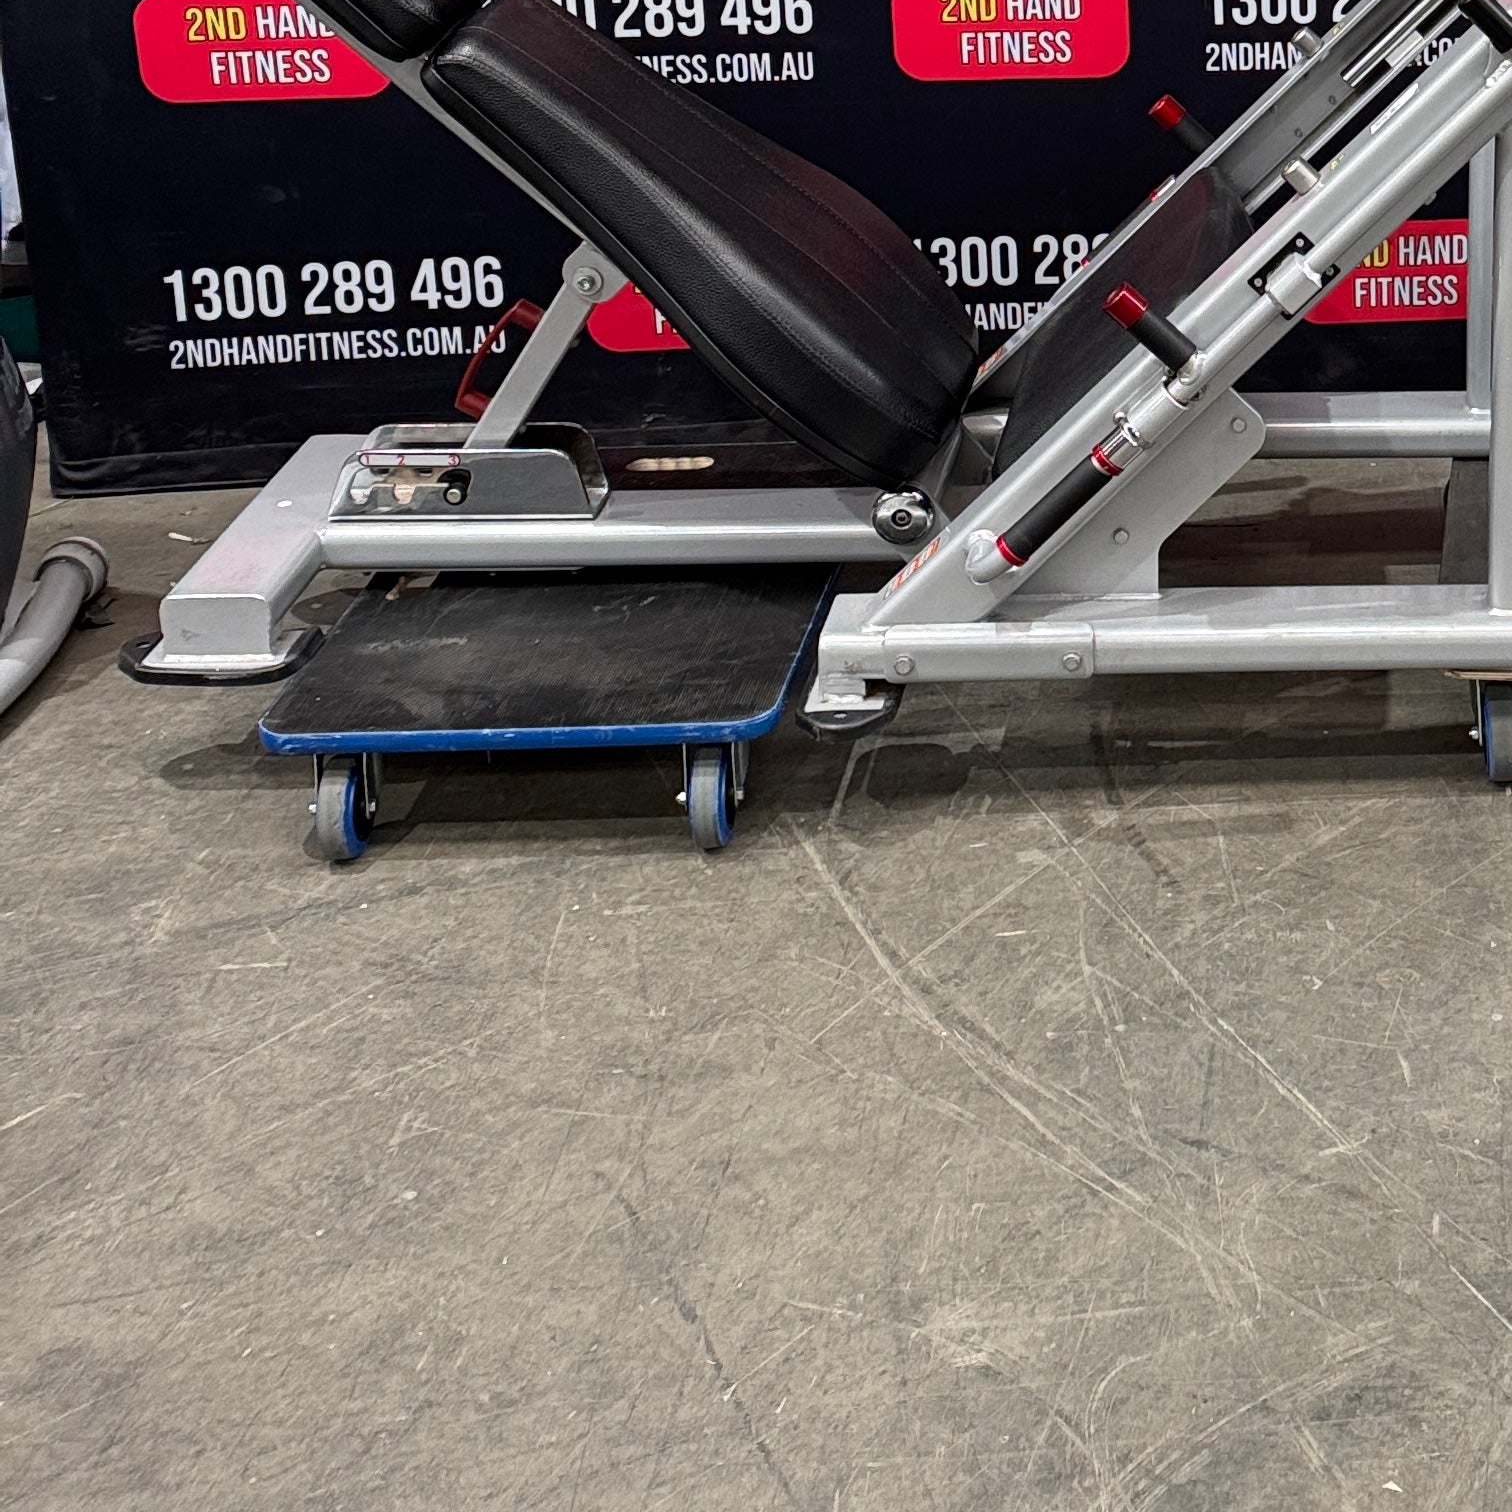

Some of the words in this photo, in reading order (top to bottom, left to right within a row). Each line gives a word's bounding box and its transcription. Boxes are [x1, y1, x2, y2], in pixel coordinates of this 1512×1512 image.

[184, 7, 247, 41] 2ND
[962, 31, 1071, 63] FITNESS
[210, 49, 331, 85] FITNESS
[913, 235, 1018, 287] 300
[1033, 233, 1109, 285] 28
[1400, 234, 1468, 266] HAND
[163, 265, 287, 322] 1300
[301, 259, 396, 316] 289
[410, 255, 505, 310] 496
[1355, 276, 1458, 308] FITNESS
[169, 325, 506, 369] 2NDHANDFITNESS.COM.AU
